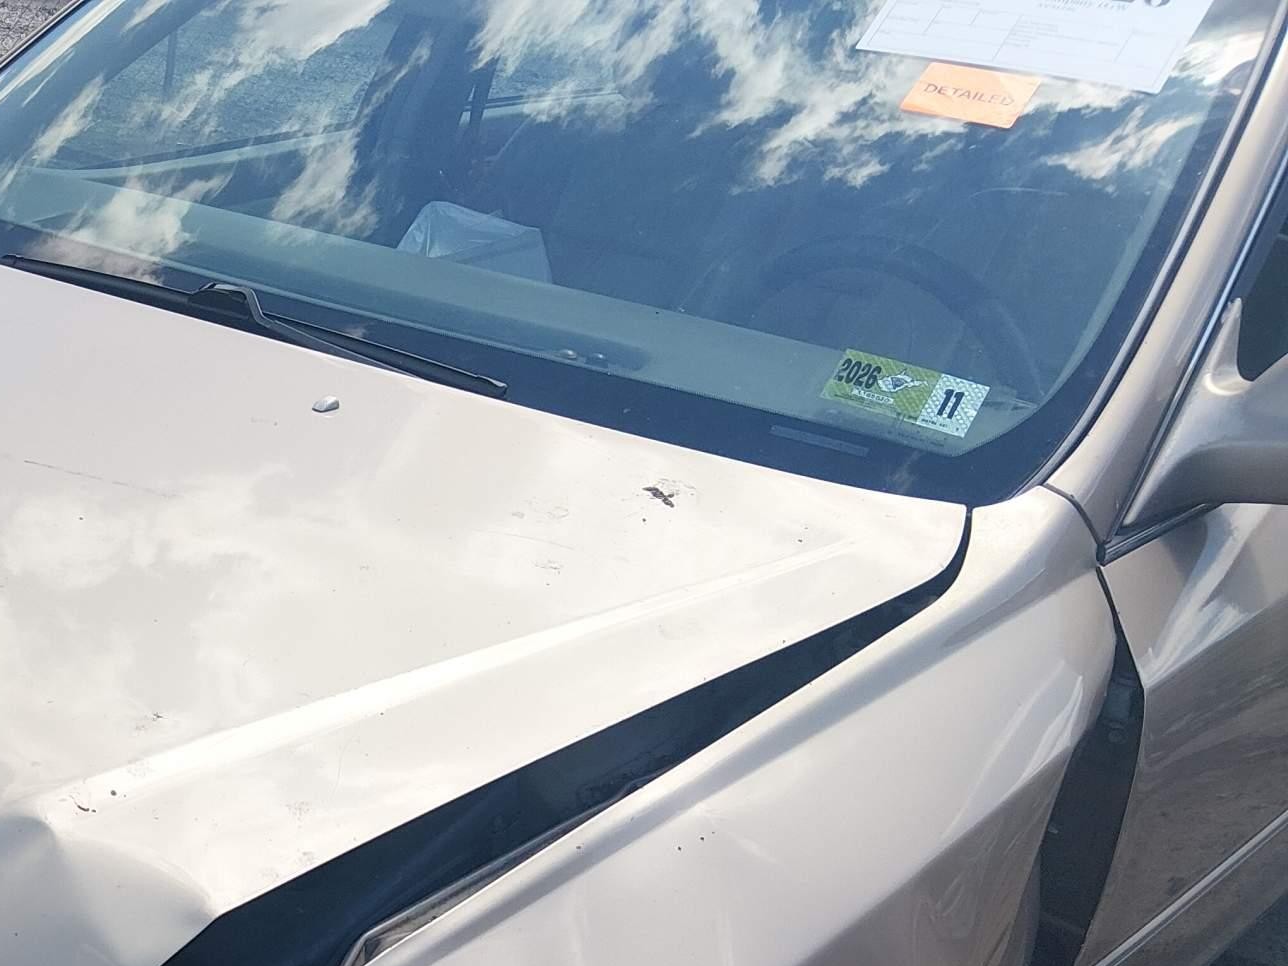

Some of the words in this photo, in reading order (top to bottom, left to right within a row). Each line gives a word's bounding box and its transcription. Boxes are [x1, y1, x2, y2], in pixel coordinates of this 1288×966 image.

[923, 83, 1015, 106] DETAILED
[833, 358, 882, 389] 2026
[936, 388, 965, 419] 11
